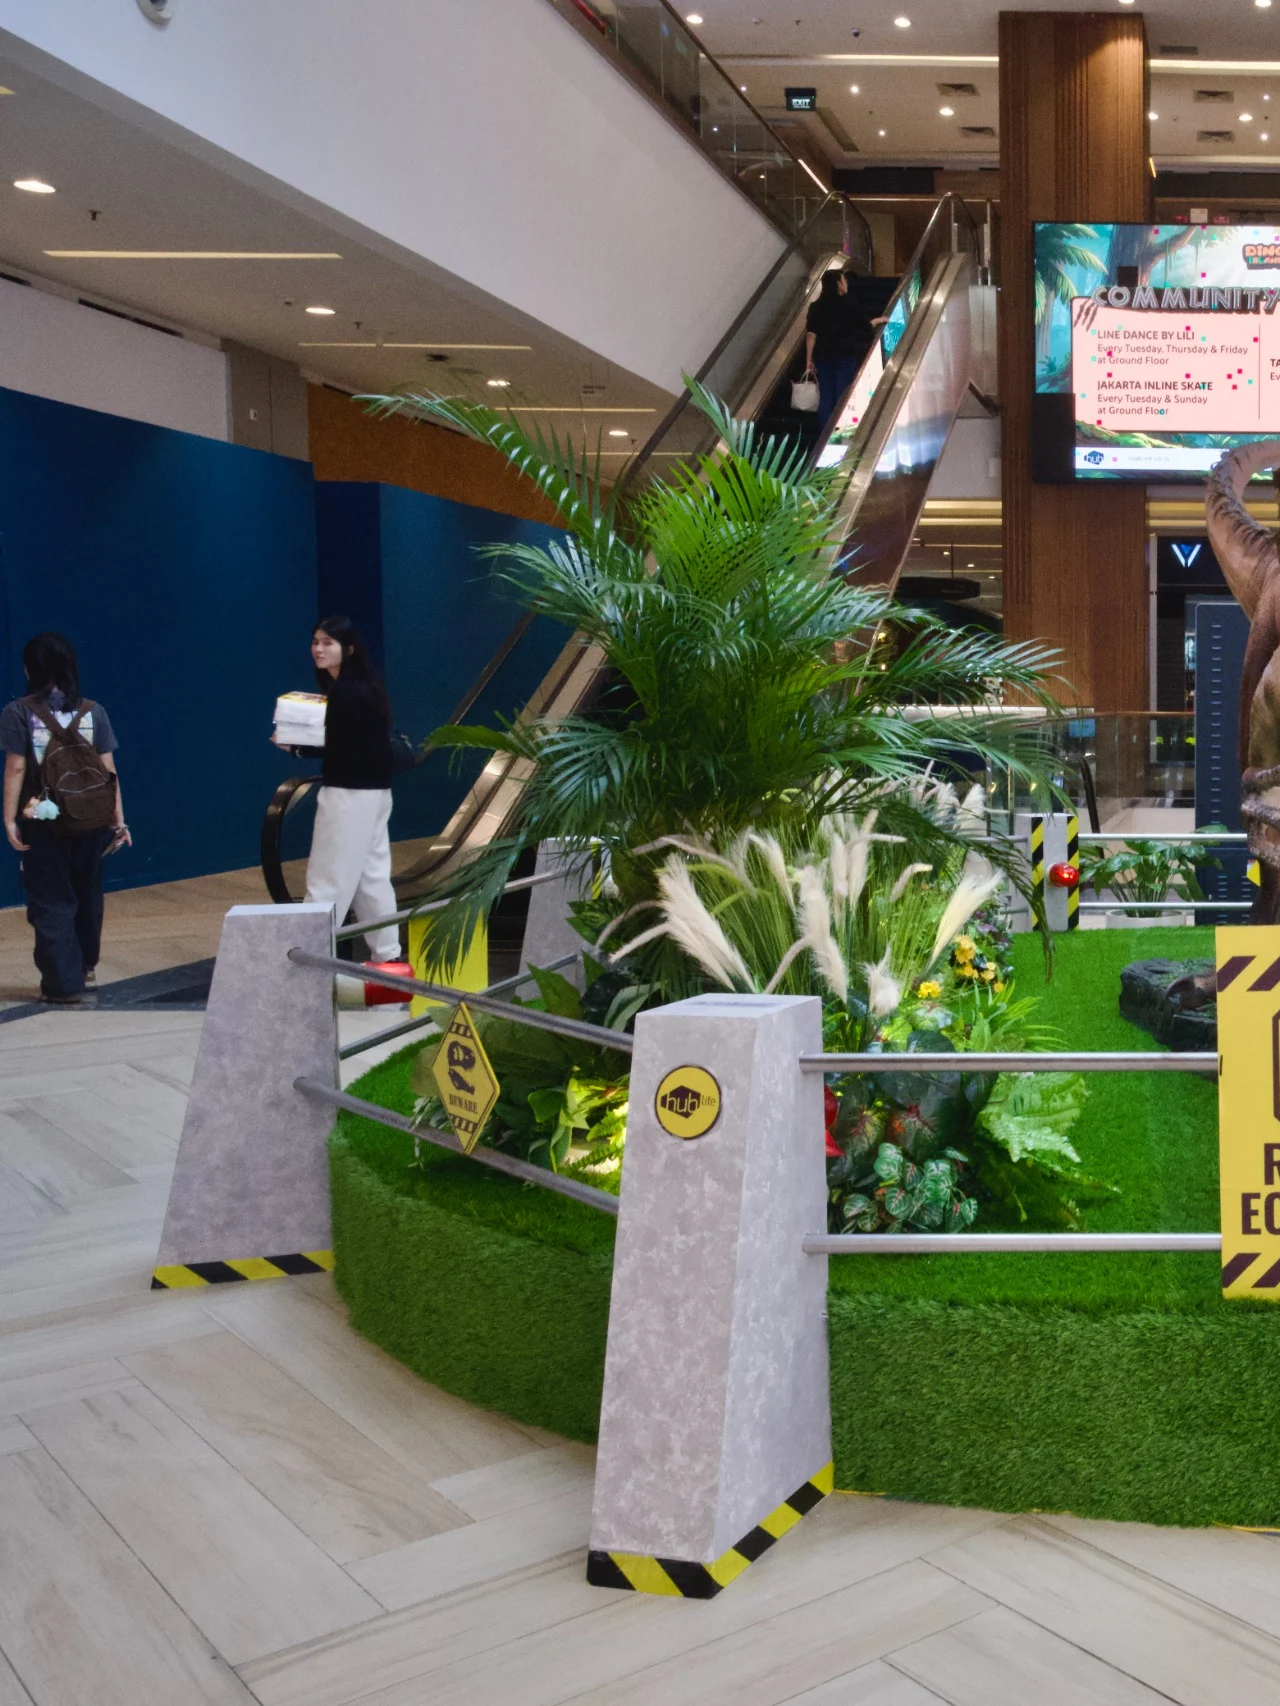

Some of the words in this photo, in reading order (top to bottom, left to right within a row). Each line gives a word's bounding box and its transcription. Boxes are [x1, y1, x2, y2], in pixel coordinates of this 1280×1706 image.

[792, 98, 810, 106] EXIT
[1097, 330, 1121, 340] LINE
[1123, 330, 1158, 340] DANCE
[1161, 331, 1174, 340] BY
[1176, 331, 1195, 341] LILI
[1097, 344, 1123, 353] Every
[1125, 344, 1164, 354] Tuesday,
[1166, 344, 1208, 354] Thursday
[1210, 345, 1217, 353] &
[1220, 345, 1248, 355] Friday
[1097, 356, 1106, 364] at
[1108, 356, 1143, 365] Ground
[1145, 356, 1169, 365] Floor
[1097, 381, 1142, 391] JAKARTA
[1144, 381, 1178, 390] INLINE
[1181, 382, 1213, 391] SKATE
[1097, 394, 1123, 403] Every
[1125, 394, 1162, 404] Tuesday
[1164, 395, 1171, 403] &
[1174, 395, 1208, 404] Sunday
[1097, 406, 1106, 414] at
[1108, 406, 1143, 415] Ground
[1145, 406, 1169, 415] Floor
[449, 1093, 478, 1115] BEWARE
[666, 1091, 699, 1114] hub
[701, 1095, 716, 1107] life
